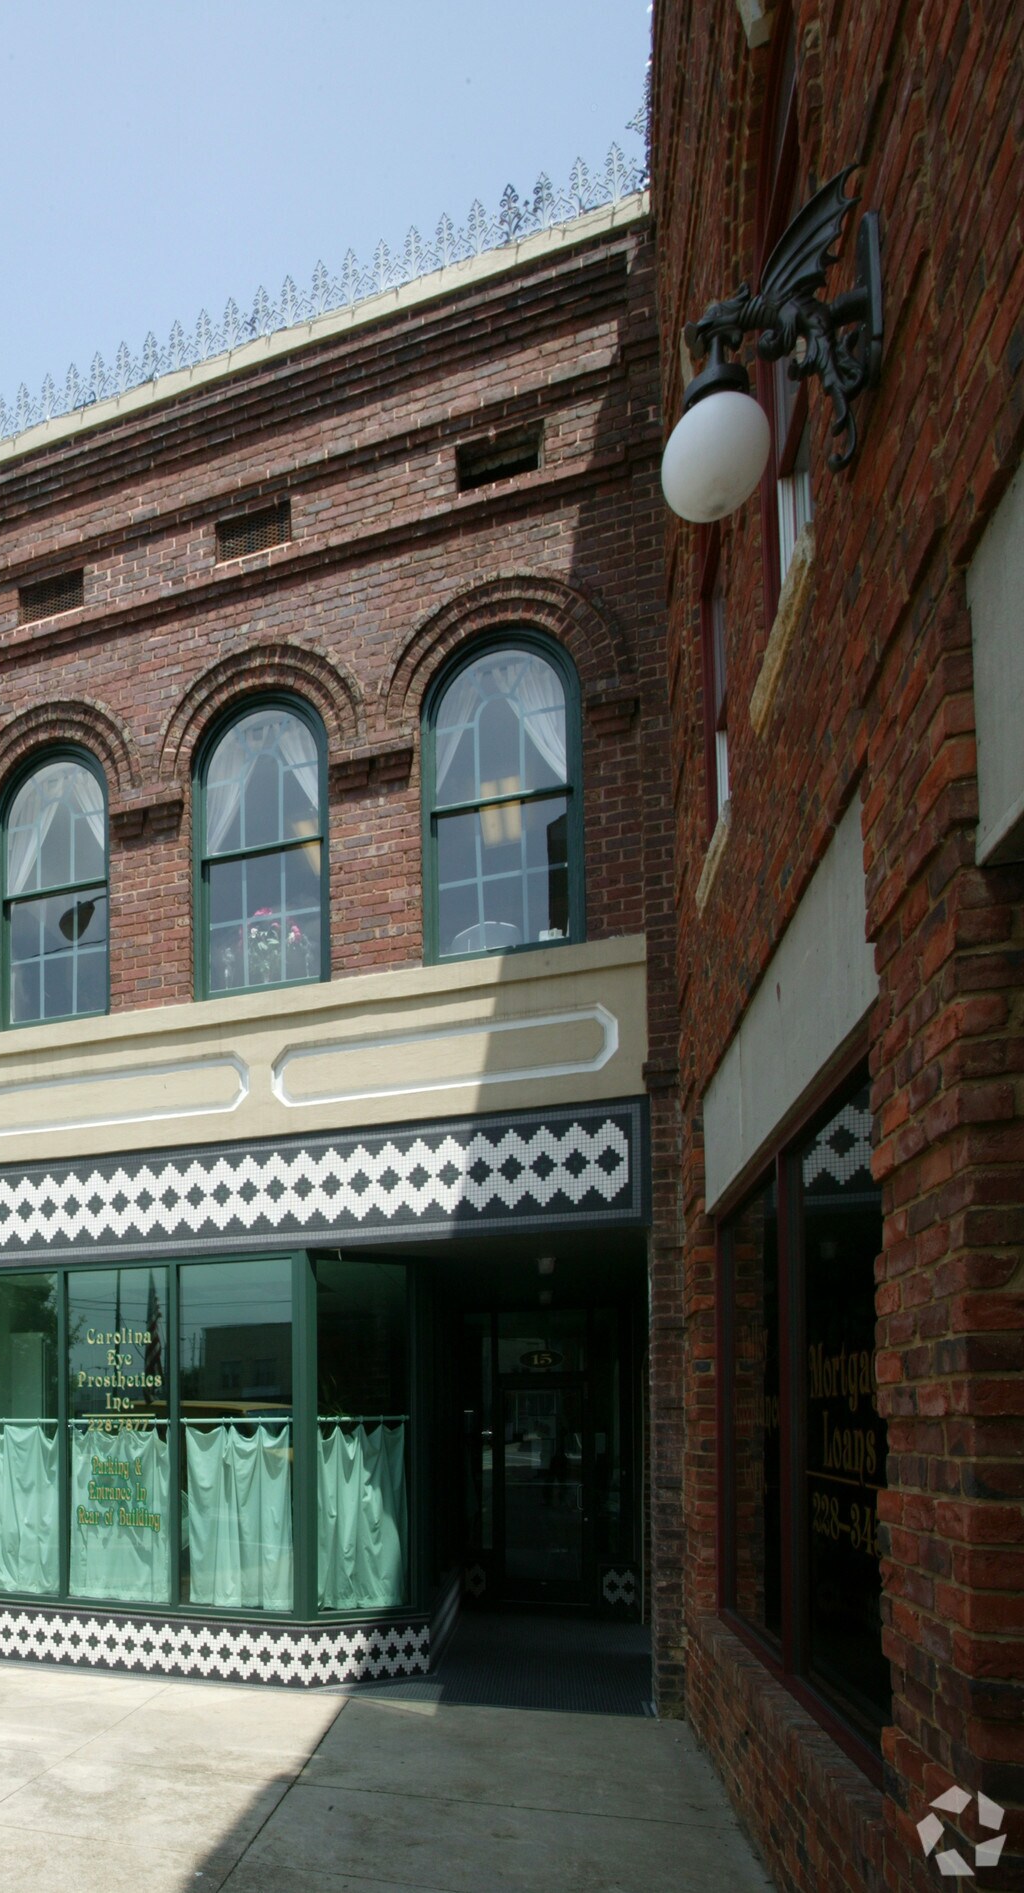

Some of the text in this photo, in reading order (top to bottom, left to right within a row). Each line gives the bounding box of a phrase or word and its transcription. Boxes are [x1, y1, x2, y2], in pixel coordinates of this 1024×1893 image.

[86, 1328, 152, 1346] Carolina
[107, 1349, 132, 1369] Eye
[531, 1354, 552, 1365] 15
[77, 1371, 163, 1390] Prosthetics
[105, 1393, 134, 1411] Inc.
[88, 1419, 149, 1432] 228-7877
[822, 1408, 877, 1487] Loans
[92, 1456, 143, 1480] Parking &
[88, 1481, 147, 1504] Entrance In
[78, 1506, 162, 1533] Rear of Building
